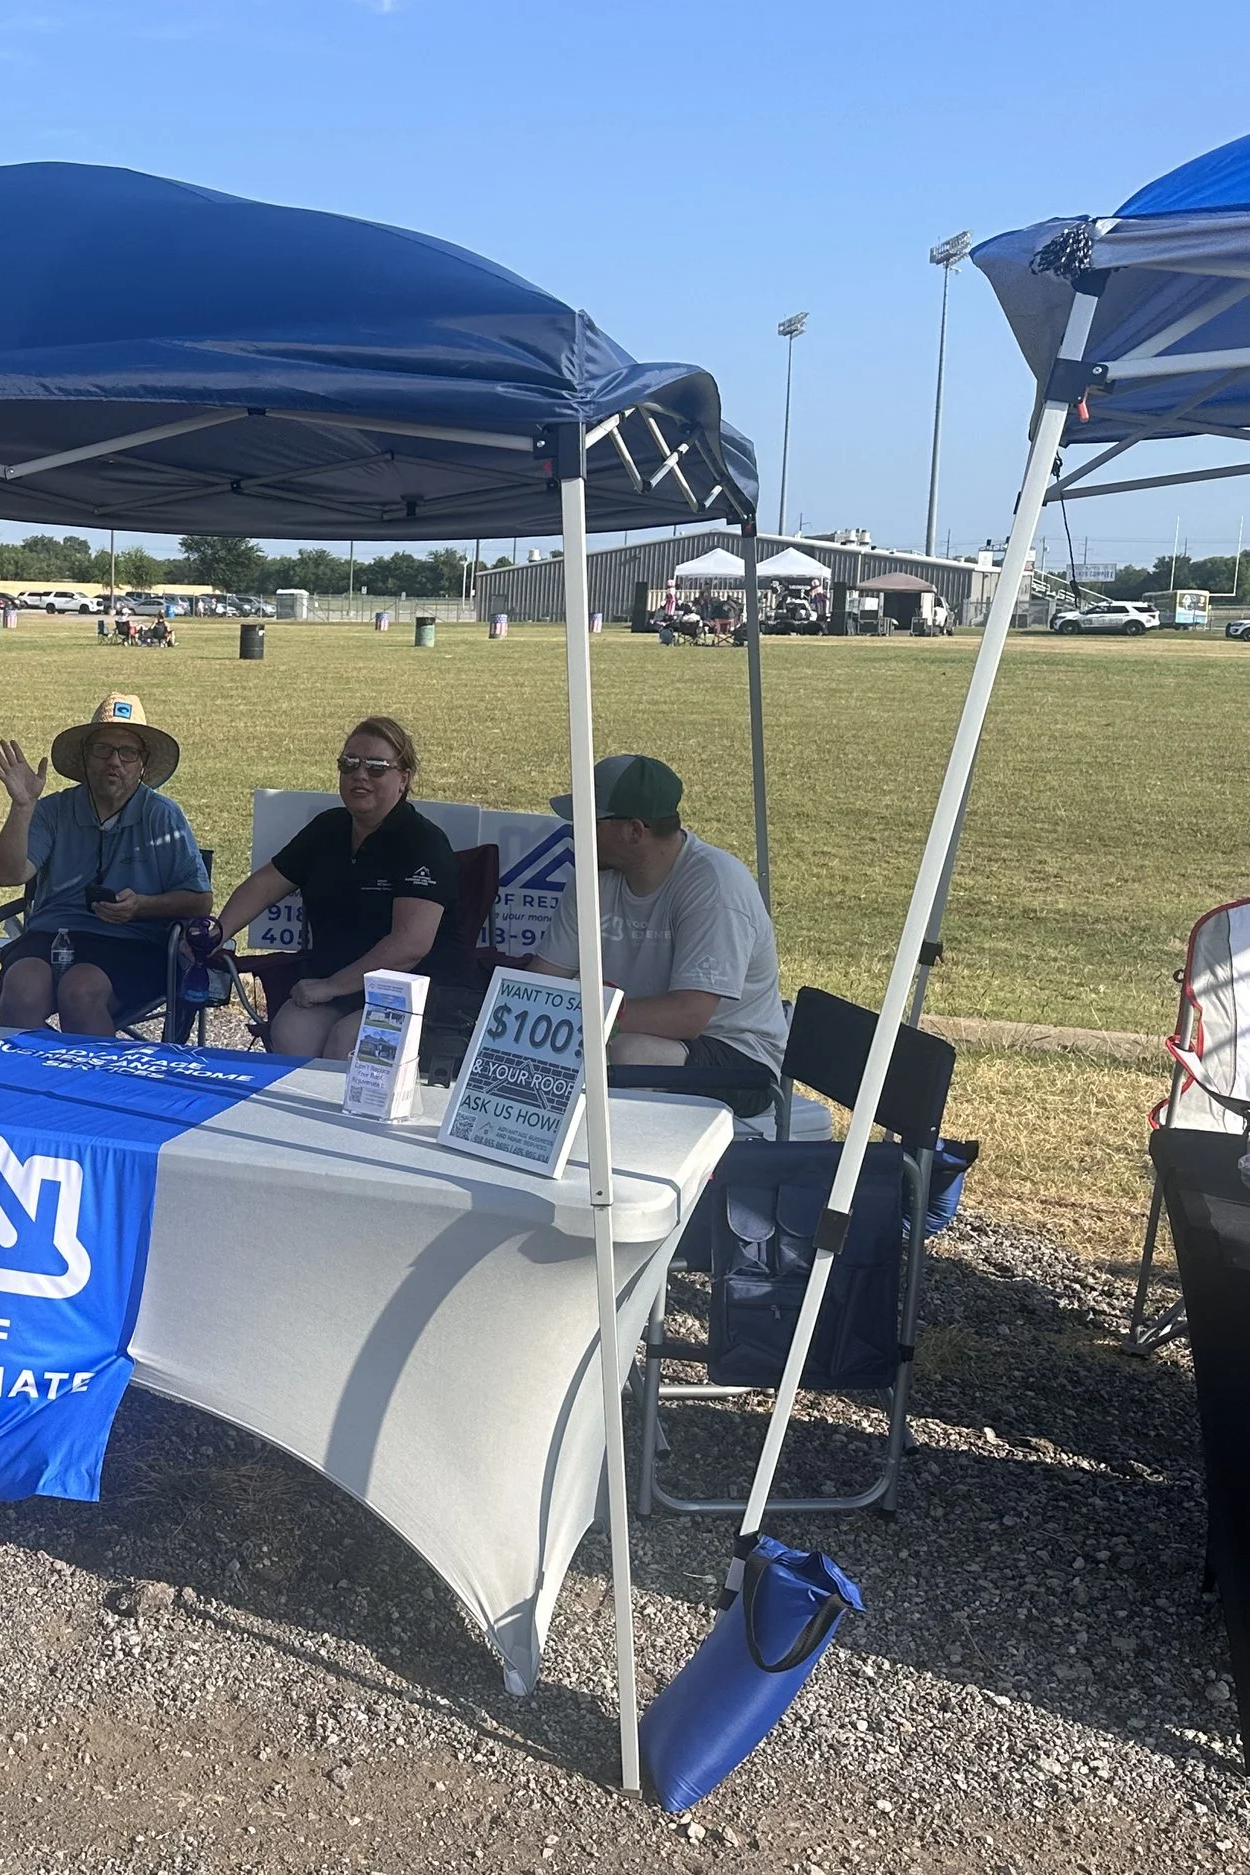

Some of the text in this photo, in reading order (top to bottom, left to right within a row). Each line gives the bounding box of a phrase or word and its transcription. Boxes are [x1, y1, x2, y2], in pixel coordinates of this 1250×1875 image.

[502, 912, 525, 922] your
[500, 982, 543, 1003] WANT
[545, 992, 564, 1008] TO
[42, 1059, 166, 1079] SERVICES
[49, 1047, 207, 1070] ADVANTAGE
[106, 1058, 169, 1072] AND
[171, 1066, 255, 1082] HOME
[472, 1059, 484, 1073] &
[488, 1063, 527, 1087] YOUR
[461, 1094, 561, 1134] ASK US HOW!
